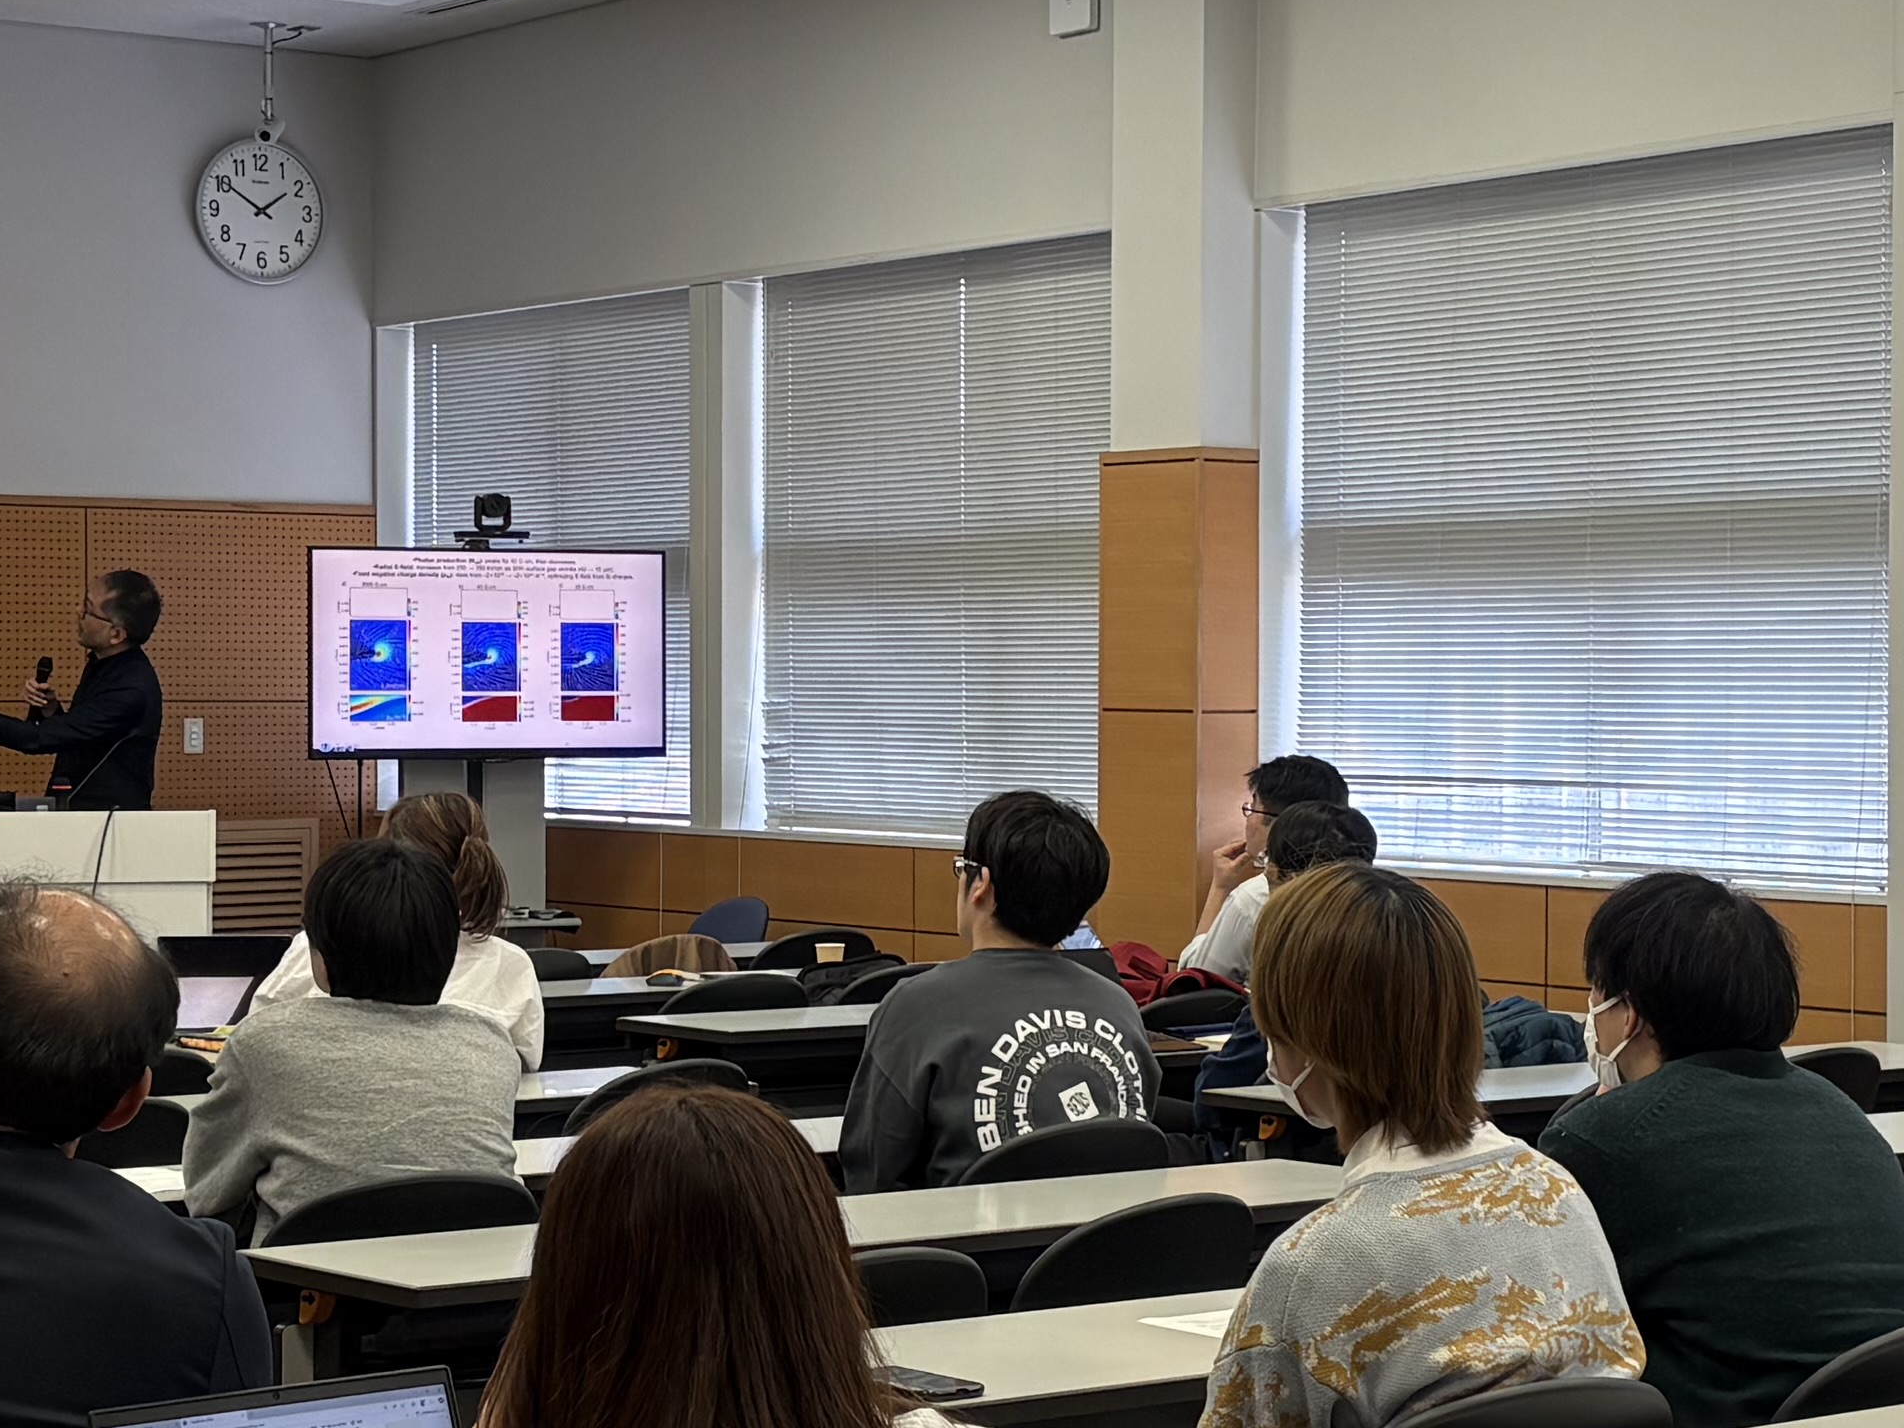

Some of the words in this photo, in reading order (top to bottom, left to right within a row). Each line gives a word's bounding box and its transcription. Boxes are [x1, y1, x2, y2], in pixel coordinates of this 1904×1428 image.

[232, 159, 246, 177] 11
[252, 154, 269, 172] 12
[279, 161, 285, 180] 1
[214, 175, 232, 193] 10
[293, 180, 304, 198] 2
[208, 199, 220, 217] 9
[301, 205, 313, 223] 3
[220, 224, 231, 242] 8
[294, 229, 304, 247] 4
[235, 243, 247, 261] 7
[256, 251, 267, 270] 6
[279, 244, 290, 264] 5
[1026, 1052, 1046, 1074] IN
[1046, 1042, 1088, 1058] SAN
[974, 1065, 1003, 1153] BEN
[991, 1009, 1087, 1063] DAVIS
